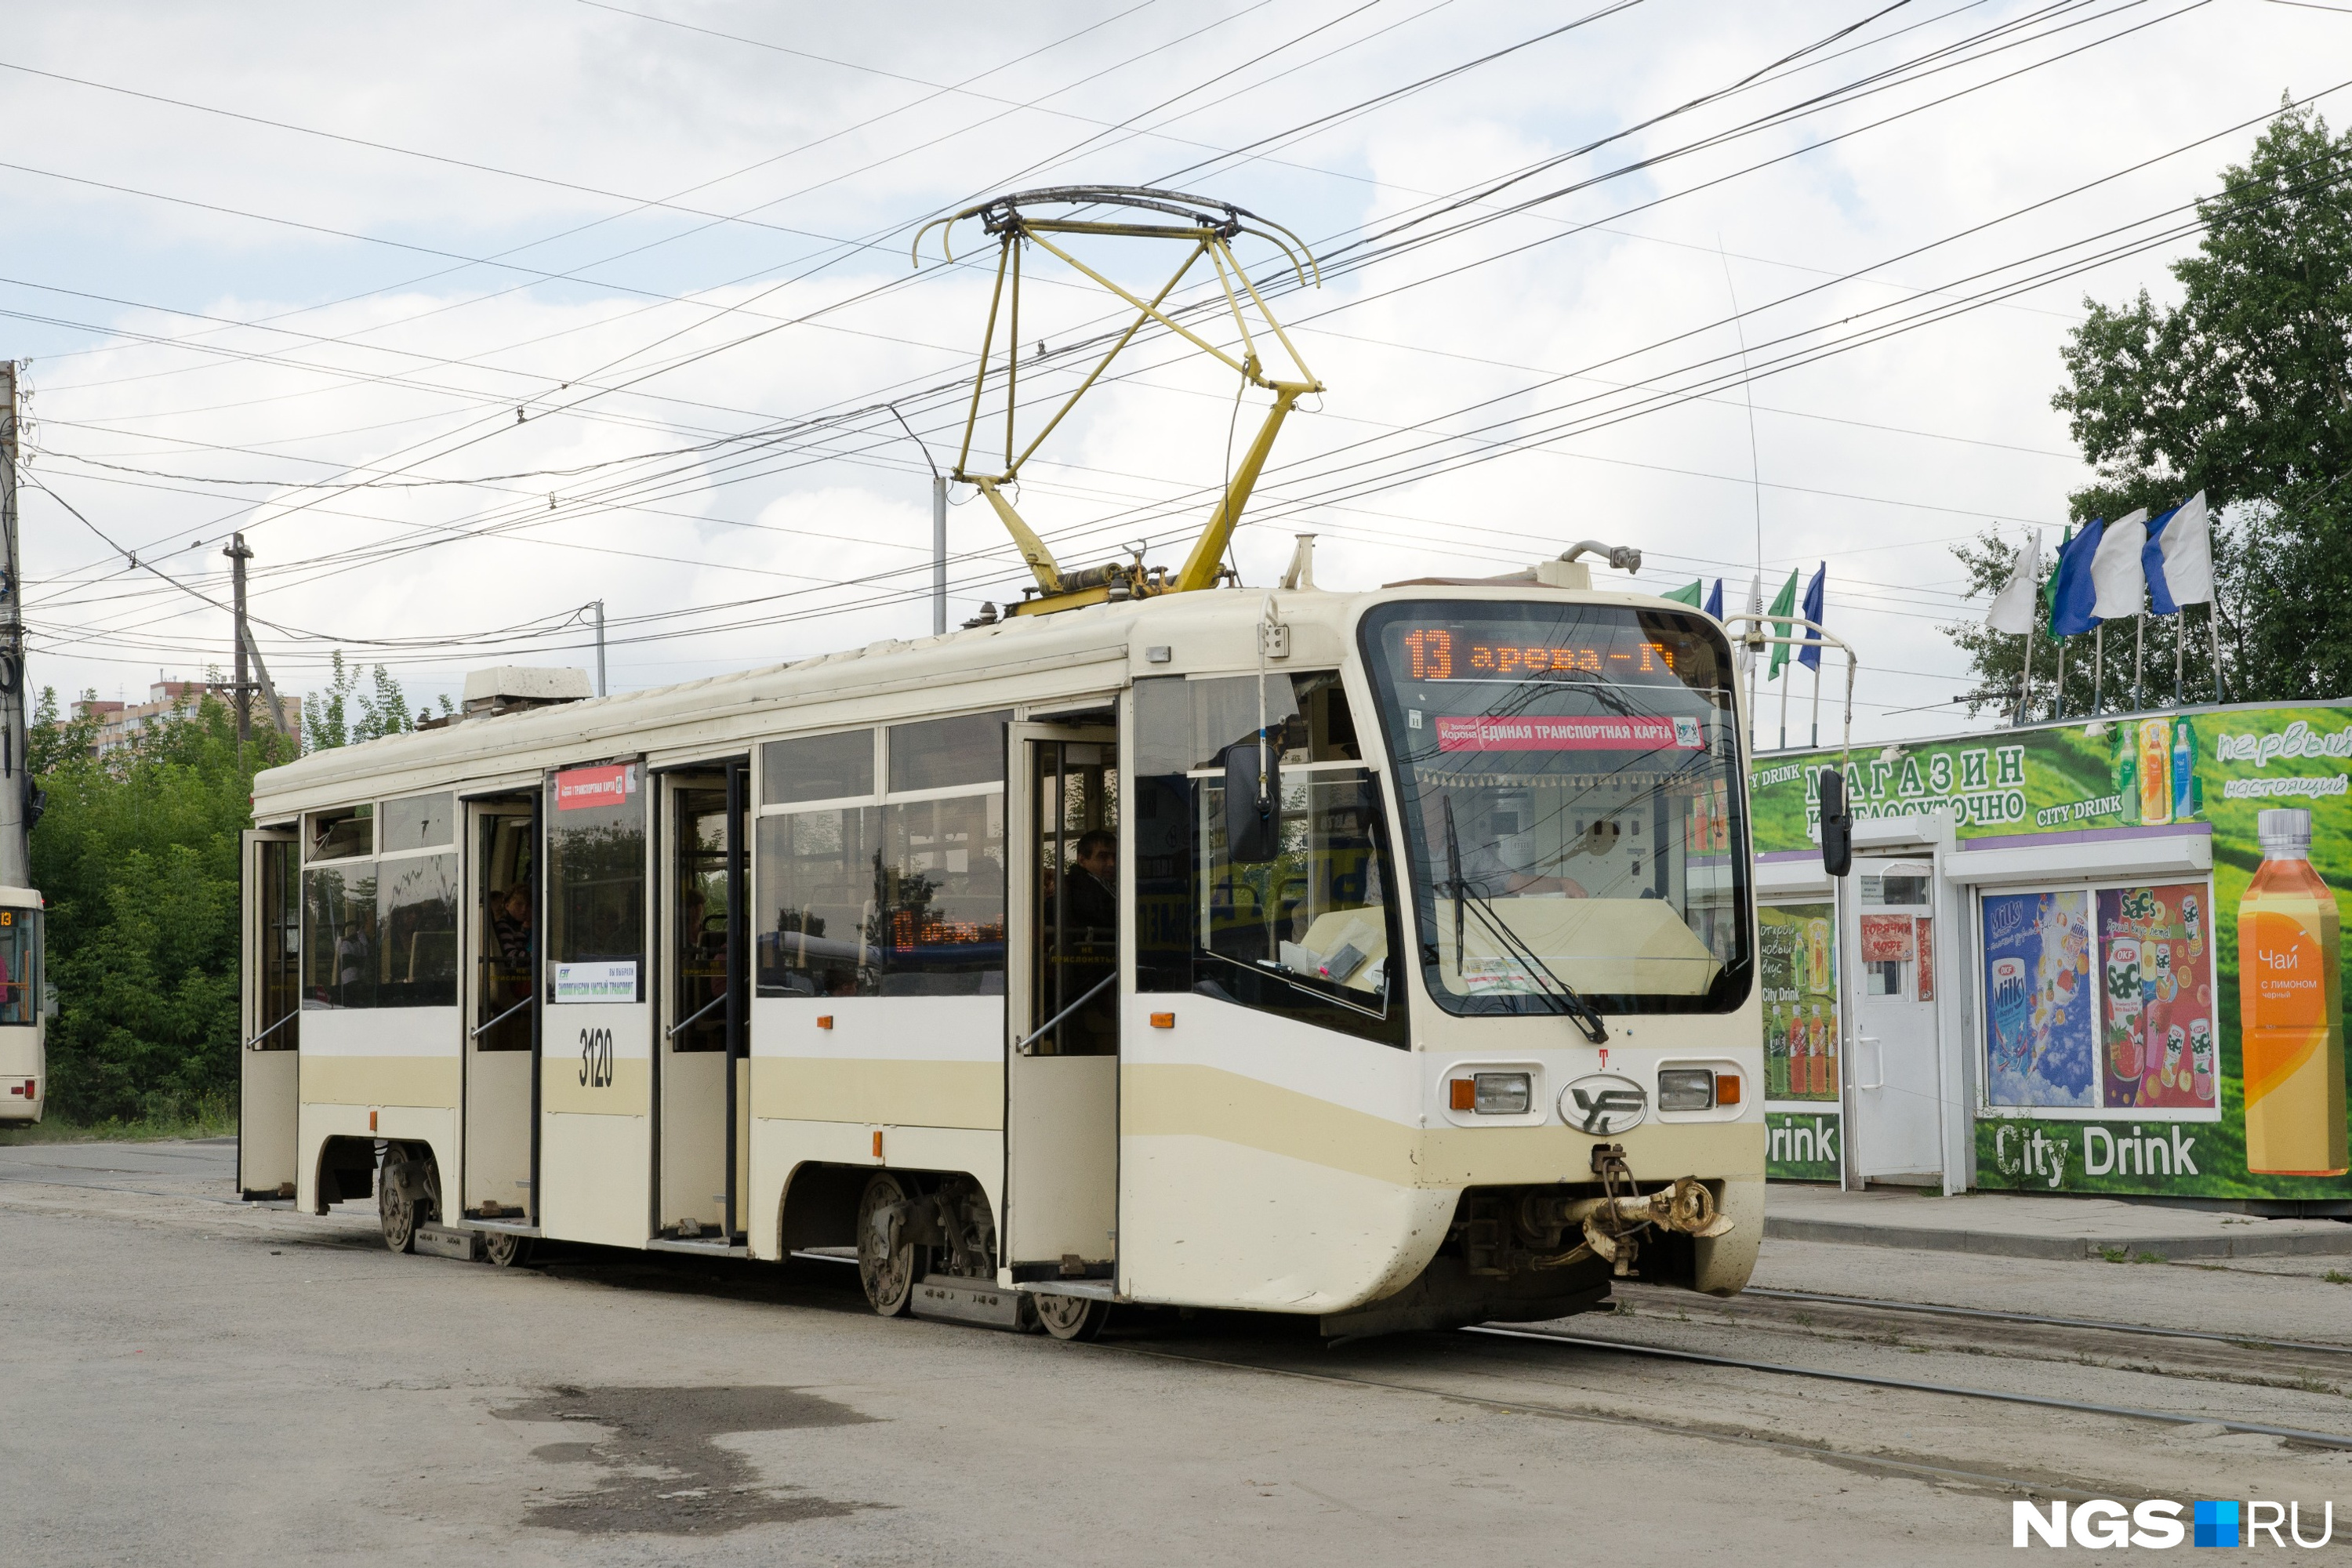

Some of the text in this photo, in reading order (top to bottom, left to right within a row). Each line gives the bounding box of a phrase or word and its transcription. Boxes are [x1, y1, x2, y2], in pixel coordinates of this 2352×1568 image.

[1405, 630, 1452, 678] 13
[1471, 647, 1602, 672] арева
[1441, 730, 1477, 741] Корона
[1481, 725, 1673, 741] ЕДИНАЯ ТРАНСПОРТНАЯ КАРТА
[2218, 722, 2352, 766] первый
[1762, 764, 1801, 787] DRINK
[2225, 775, 2347, 797] настоящий
[2036, 795, 2122, 828] CITY DRINK
[1, 912, 12, 926] 13
[1991, 899, 2023, 931] Milky
[1760, 922, 1795, 939] открой
[1862, 921, 1912, 937] ГОРЯЧИЙ
[2131, 921, 2147, 938] вкус
[1761, 939, 1791, 955] новый
[1872, 941, 1904, 953] КОФЕ
[2117, 950, 2133, 960] OKF
[2259, 945, 2299, 969] Чай
[609, 968, 615, 977] ВЫ
[616, 967, 633, 976] ВЫБРАЛИ
[558, 980, 633, 996] ЭКОЛОГИЧЕСКИ ЧИСТЫЙ ТРАНСПОРТ
[1762, 987, 1800, 1004] City Drink
[1994, 976, 2025, 1011] Milky
[2262, 991, 2291, 1000] черный
[579, 1028, 612, 1087] 3120
[1765, 1117, 1836, 1162] rink
[1995, 1124, 2199, 1188] City Drink
